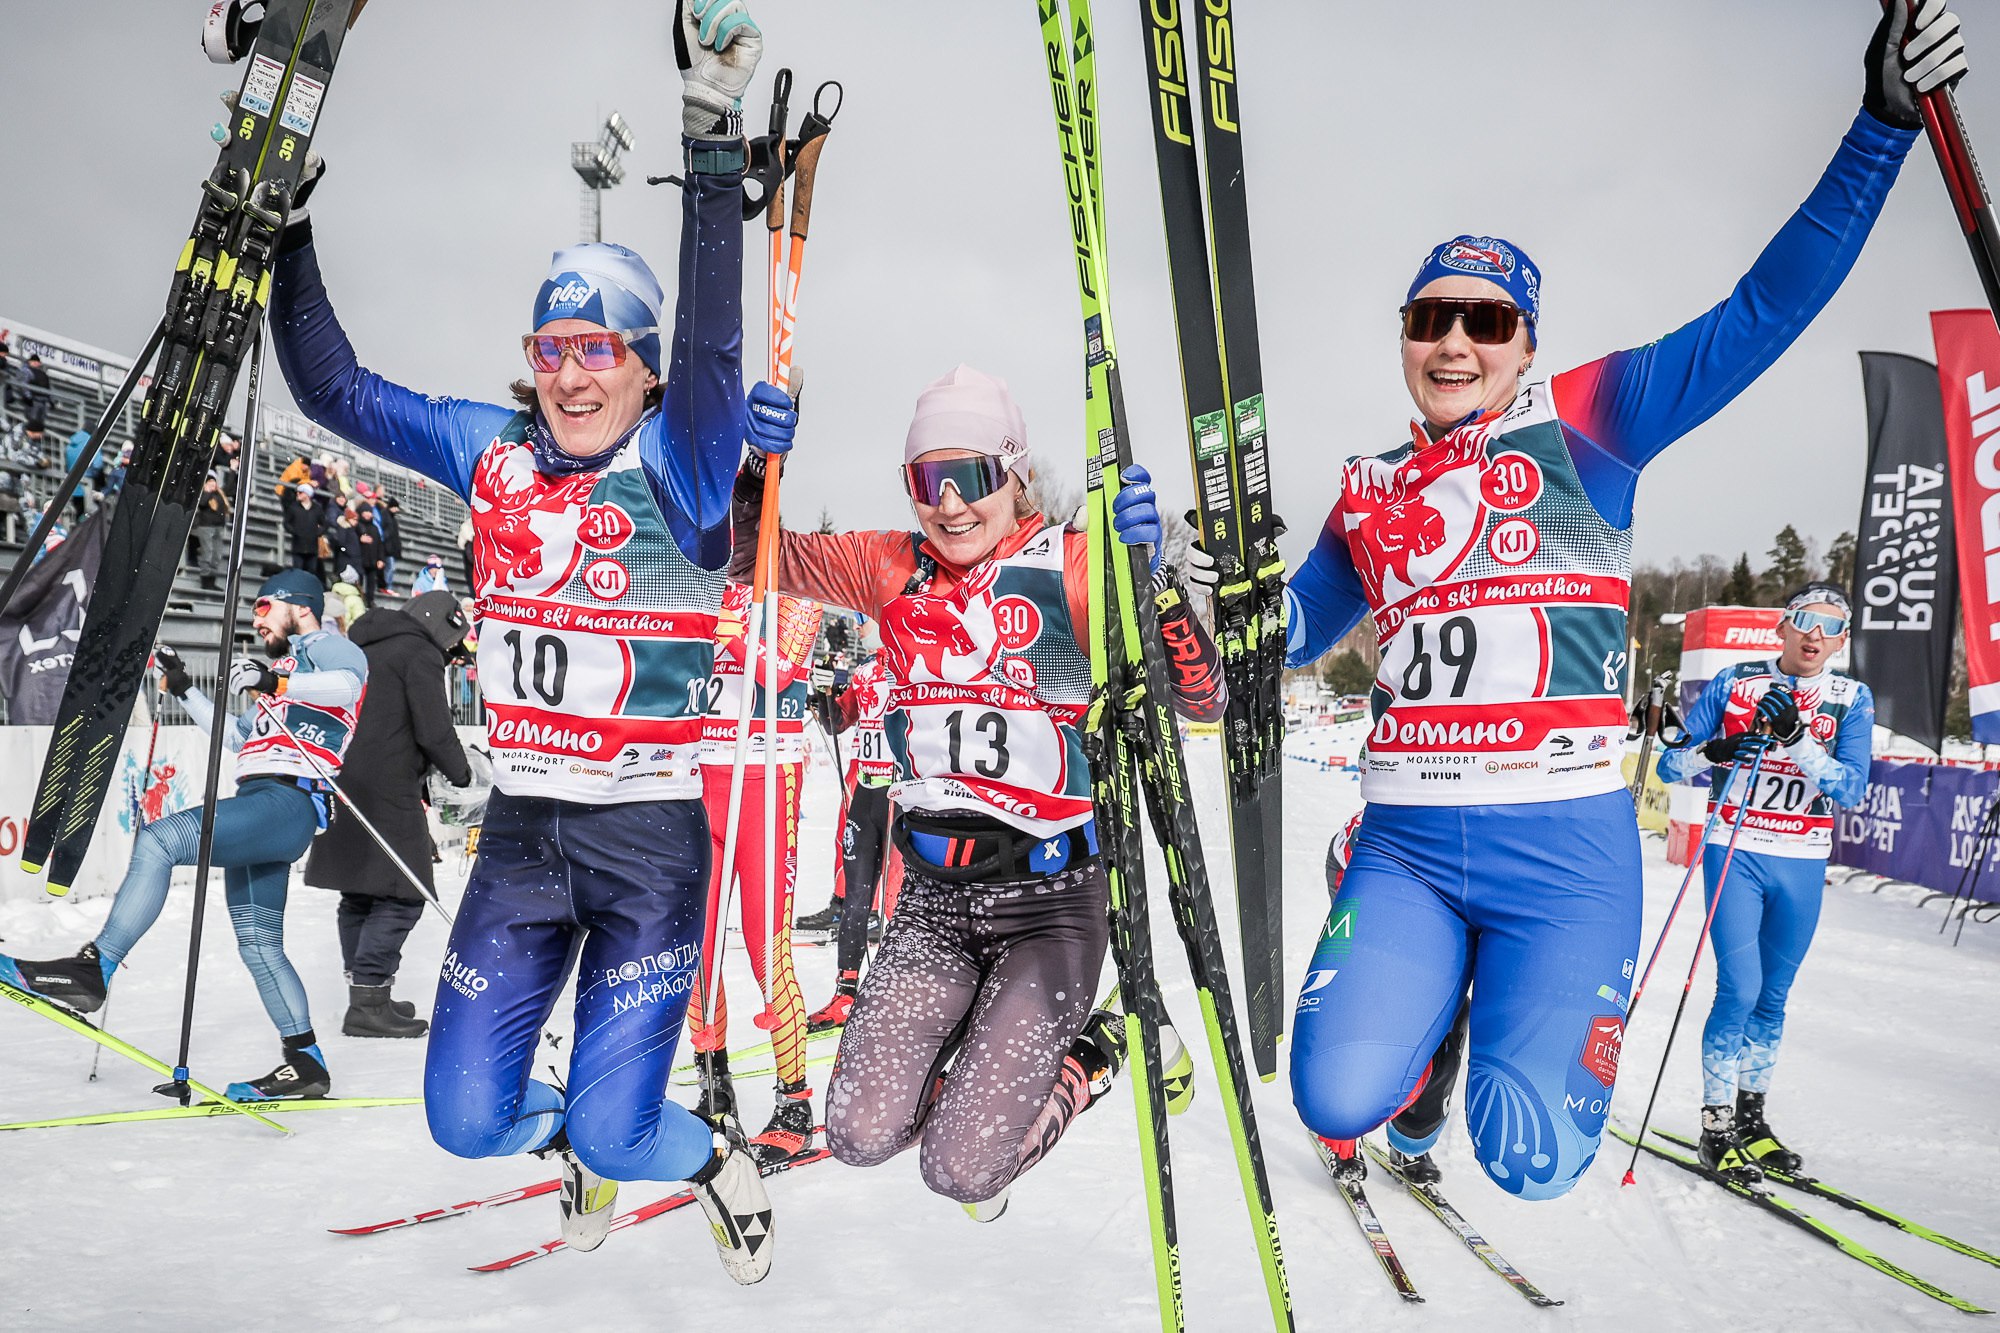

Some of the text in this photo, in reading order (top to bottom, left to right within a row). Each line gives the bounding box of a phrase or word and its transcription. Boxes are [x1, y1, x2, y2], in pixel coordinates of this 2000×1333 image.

[239, 117, 256, 141] 3D
[278, 138, 296, 162] 3D
[1048, 40, 1096, 301] FISCHER
[1493, 462, 1527, 494] 30
[588, 504, 621, 537] 30
[1252, 503, 1263, 524] 3D
[1214, 522, 1227, 541] 3D
[1499, 530, 1528, 555] КЛ
[592, 567, 620, 591] КЛ
[1447, 582, 1478, 608] ski
[1484, 576, 1592, 600] marathon
[486, 595, 538, 620] Demino
[542, 607, 571, 629] ski
[574, 611, 674, 632] marathon
[998, 605, 1028, 635] 30
[1724, 627, 1785, 646] FINIS
[1161, 617, 1216, 694] CRA
[1400, 615, 1478, 701] 69
[503, 629, 569, 707] 10
[684, 676, 707, 715] 10
[707, 676, 724, 716] 2
[916, 683, 977, 700] Demino
[981, 689, 1007, 707] ski
[781, 697, 799, 718] 52
[295, 722, 325, 746] 256
[486, 708, 603, 753] Демино
[1372, 712, 1524, 746] Демино
[1815, 718, 1831, 734] 30
[864, 731, 882, 760] 81
[943, 709, 1010, 779] 13
[1157, 704, 1185, 804] FISCHER
[503, 751, 566, 766] MOAXSPORT
[511, 765, 548, 776] BIVIUM
[1406, 756, 1478, 765] MOAXSPORT
[1594, 760, 1611, 770] PRO
[656, 770, 673, 778] PRO
[1116, 729, 1134, 829] FISCHER
[1421, 772, 1461, 780] BIVIUM
[1748, 775, 1807, 812] 120
[1820, 797, 1833, 815] 12
[606, 940, 700, 988] ВОЛОГДА
[35, 976, 72, 985] salomon
[451, 977, 478, 1001] team
[761, 1160, 790, 1176] STC
[1764, 1169, 1794, 1183] FISCHER
[1727, 1181, 1752, 1196] FISCHER
